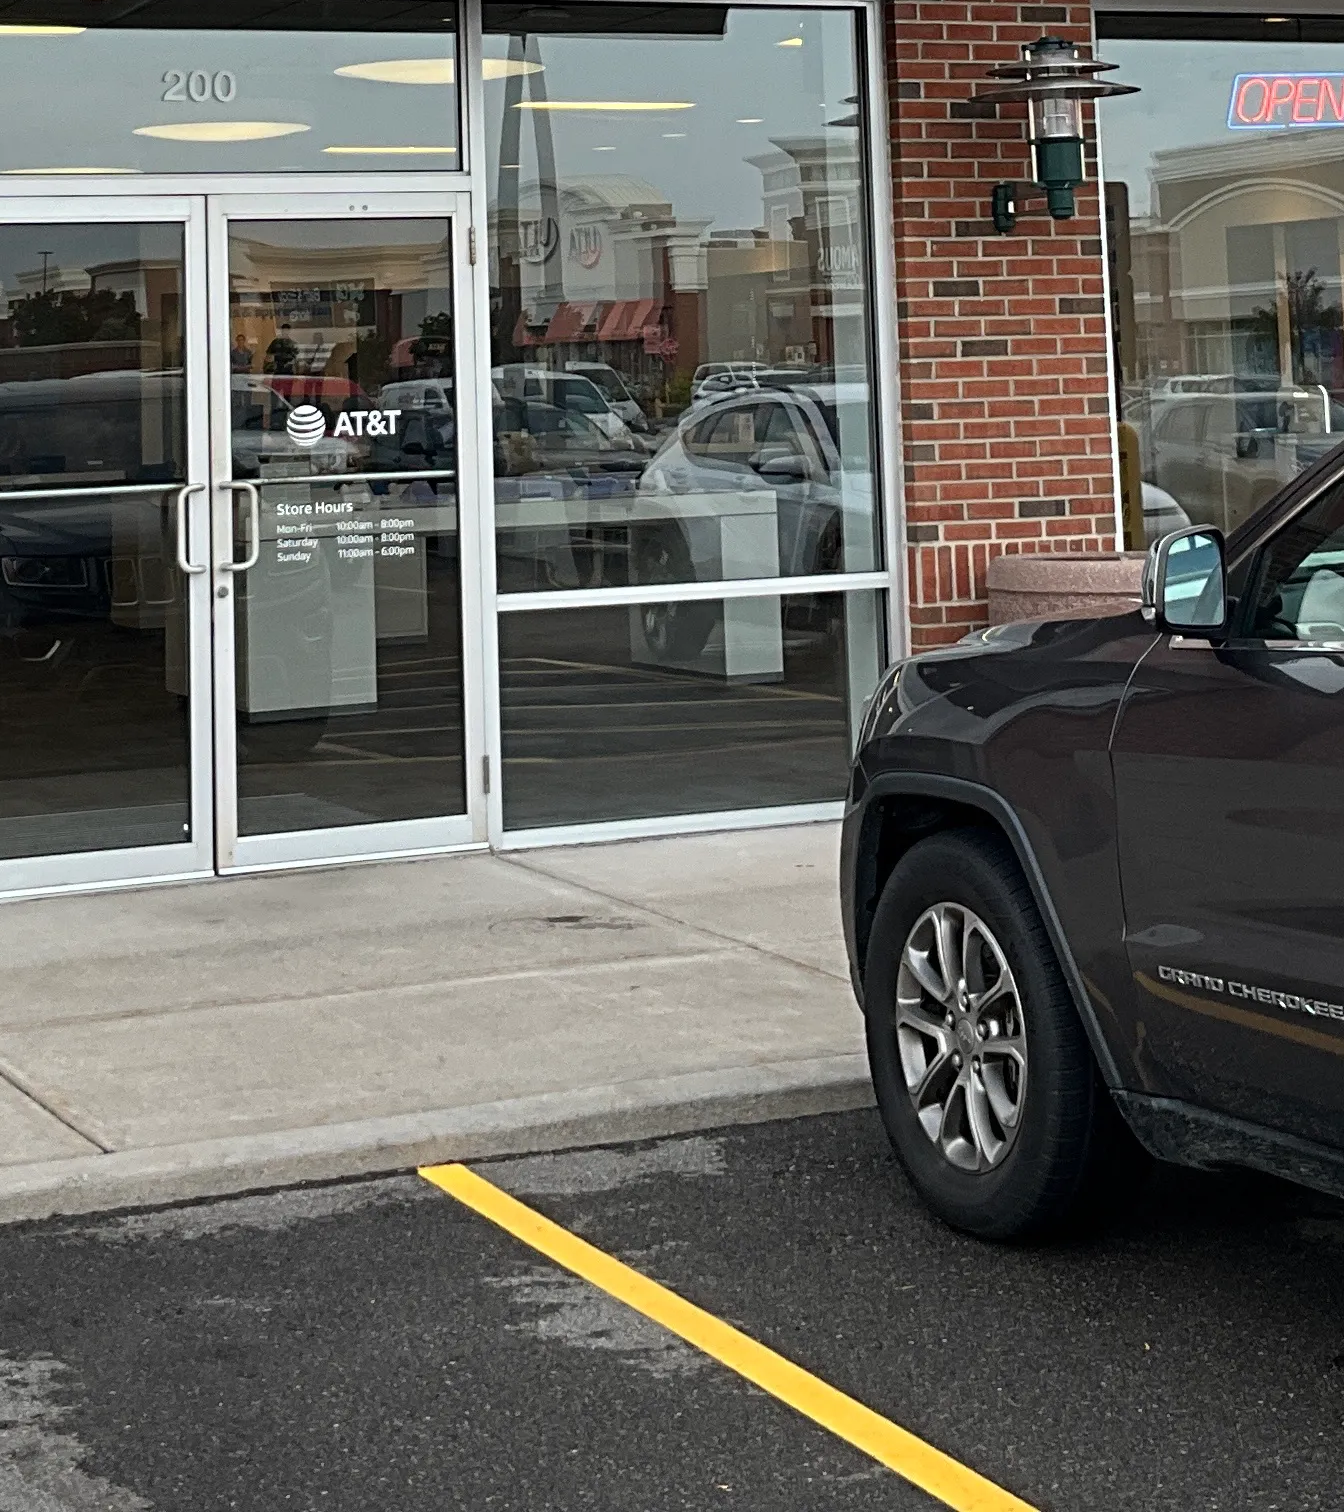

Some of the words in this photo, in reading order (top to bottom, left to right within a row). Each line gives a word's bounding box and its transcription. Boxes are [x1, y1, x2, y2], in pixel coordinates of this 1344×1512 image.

[160, 70, 238, 103] 200
[332, 408, 402, 437] AT&T
[276, 502, 313, 516] Store
[314, 501, 354, 514] Hours
[276, 522, 313, 534] Mon-Fri
[336, 520, 373, 531] 10:00am
[380, 519, 415, 530] 8:00pm
[276, 537, 319, 549] Saturday
[336, 534, 373, 545] 10:00am
[380, 532, 415, 543] 8:00pm
[276, 550, 312, 563] Sunday
[337, 548, 373, 559] 11:00am
[1158, 965, 1225, 993] GRAND
